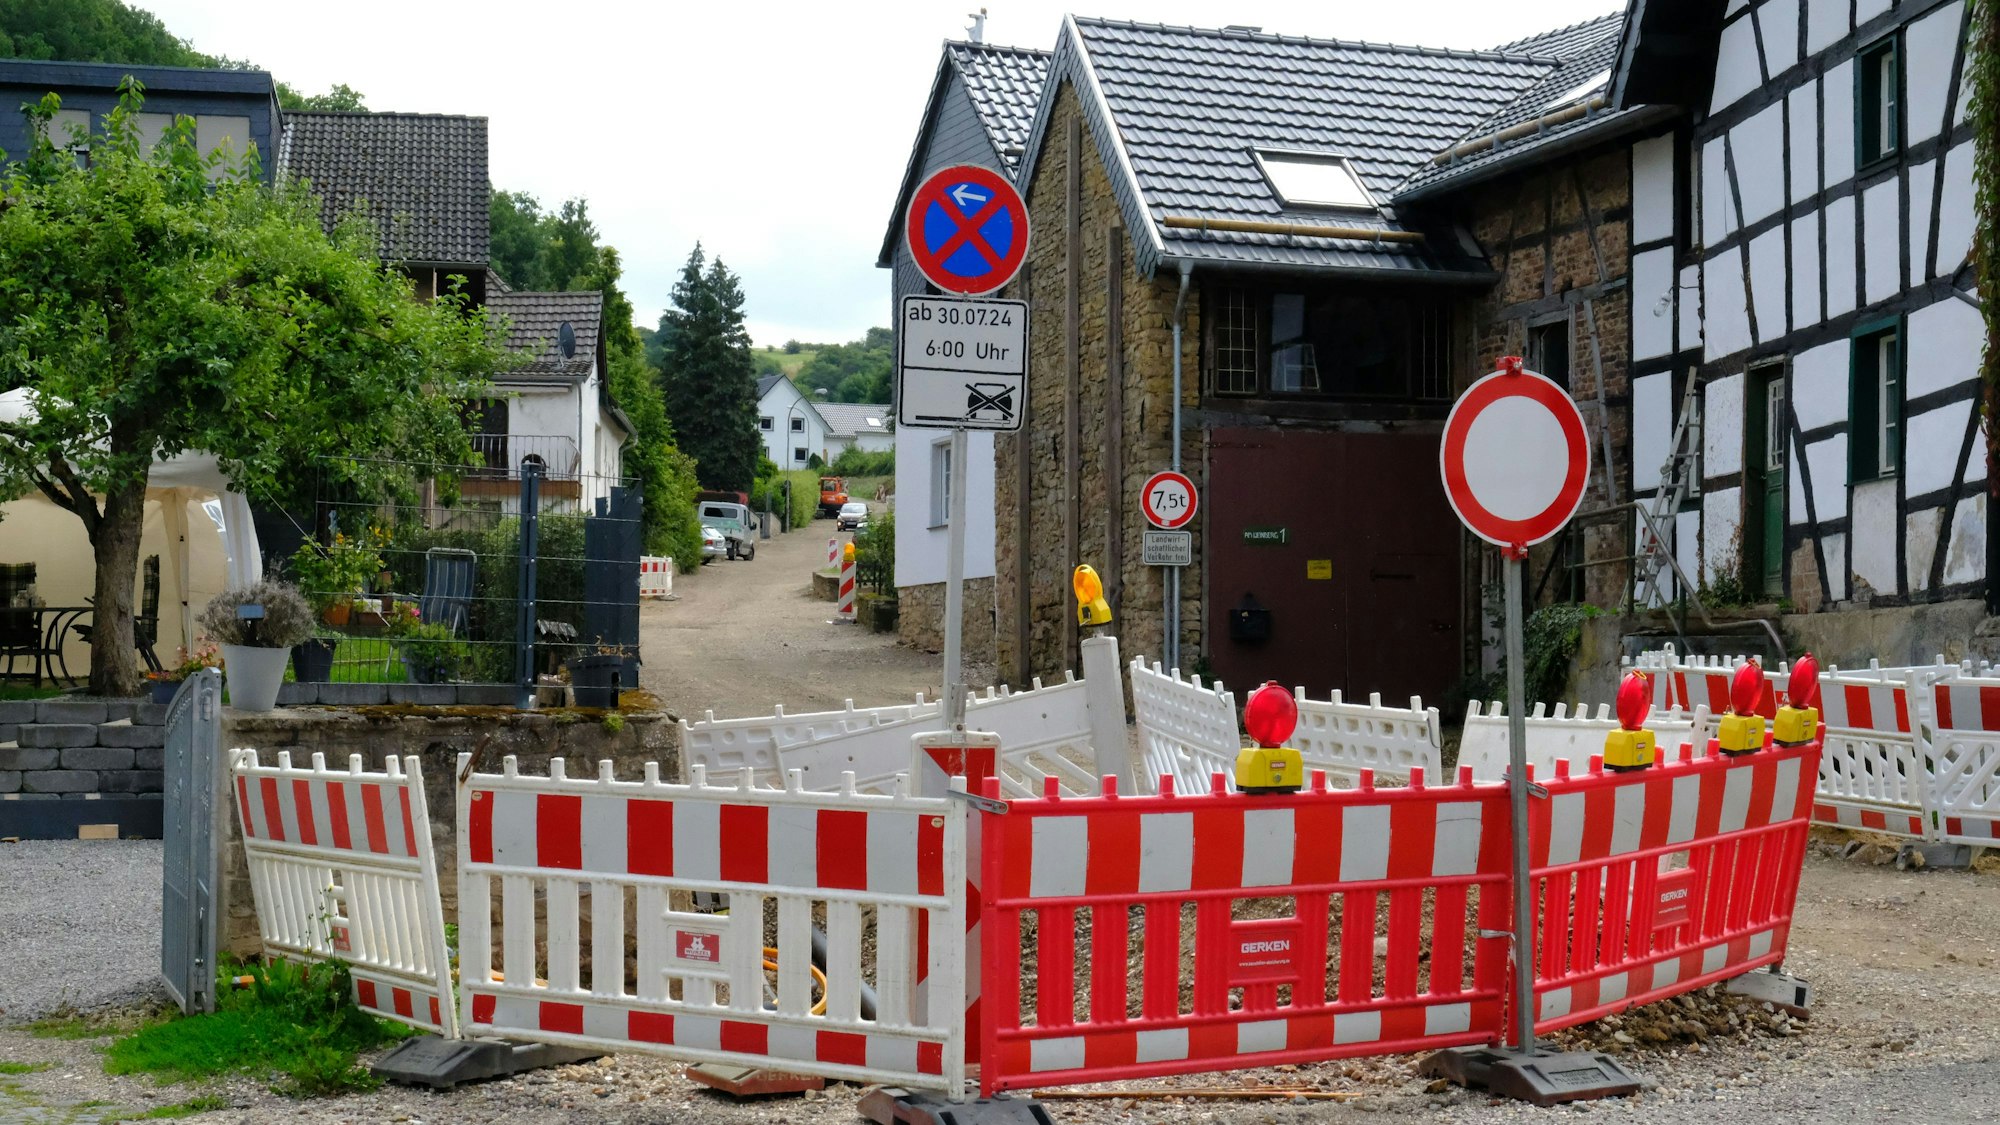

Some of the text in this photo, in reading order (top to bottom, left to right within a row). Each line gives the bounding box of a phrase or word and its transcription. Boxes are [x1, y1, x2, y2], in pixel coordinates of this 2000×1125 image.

[909, 302, 1012, 327] ab 30.07.24
[925, 339, 1010, 360] 6:00 Uhr
[1660, 888, 1688, 903] GERKEN
[1241, 940, 1290, 954] GERKEN
